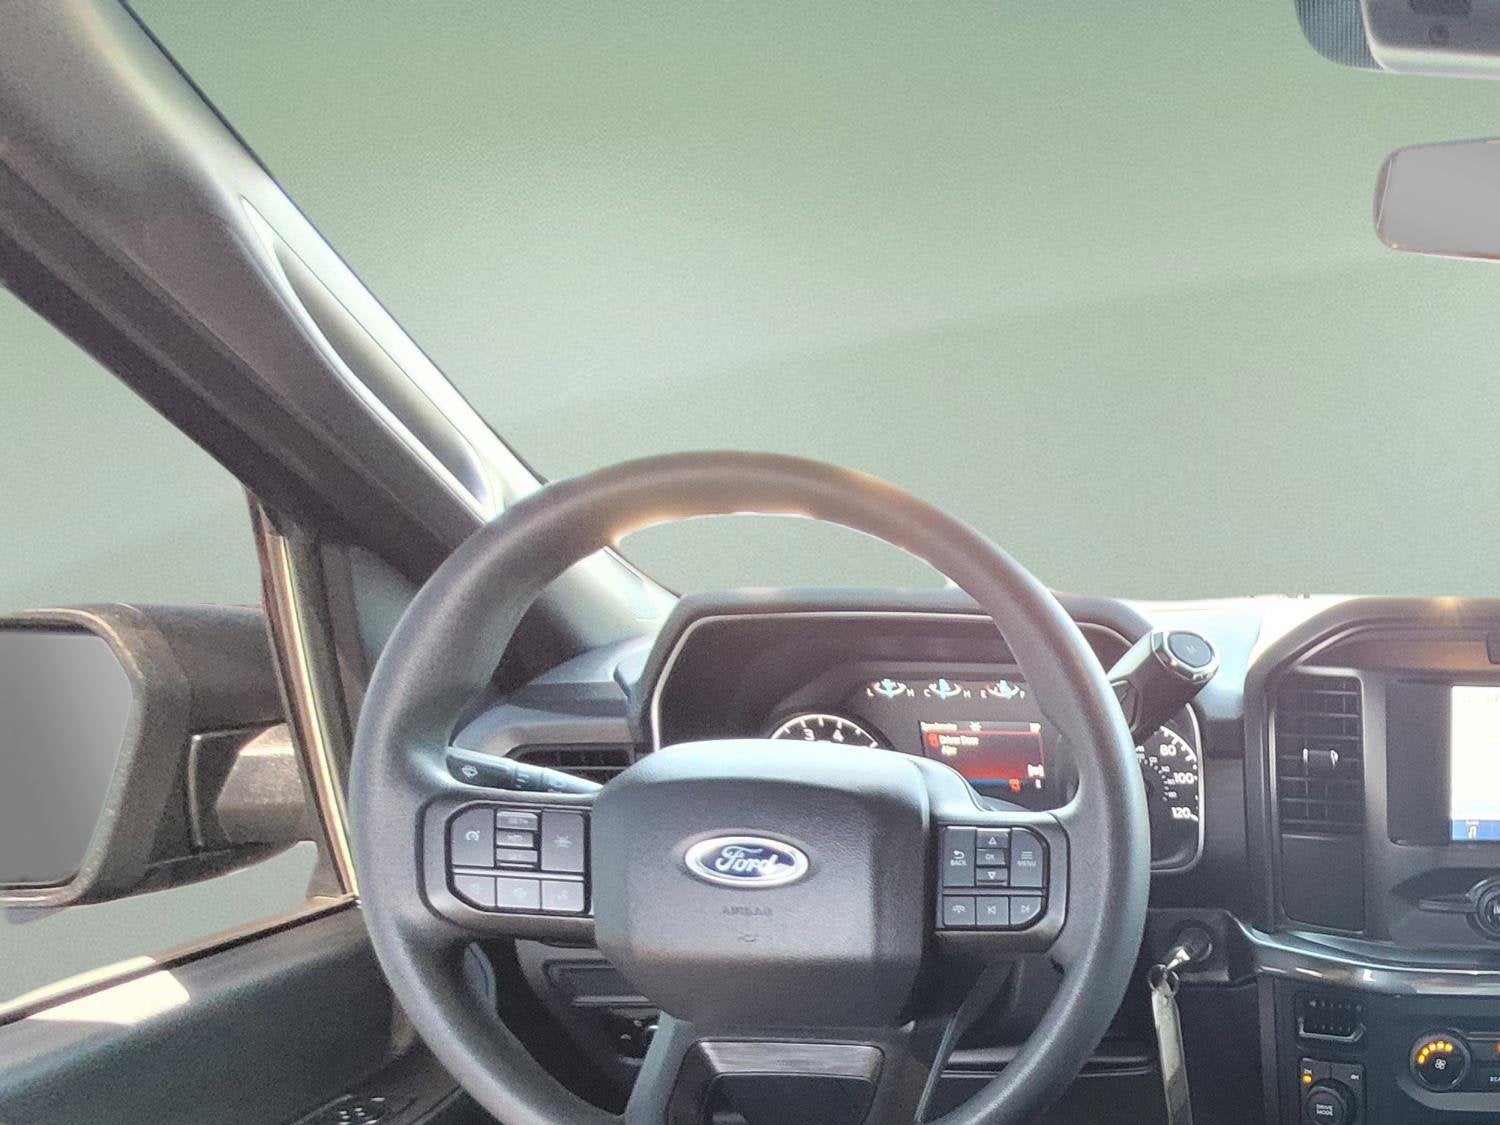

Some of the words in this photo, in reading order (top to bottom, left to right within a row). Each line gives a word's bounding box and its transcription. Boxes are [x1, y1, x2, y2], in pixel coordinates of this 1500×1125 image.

[803, 729, 815, 741] 3
[832, 729, 844, 741] 4
[1160, 744, 1177, 756] 80
[1173, 772, 1195, 785] 100
[1171, 806, 1192, 819] 120
[715, 845, 780, 874] Ford
